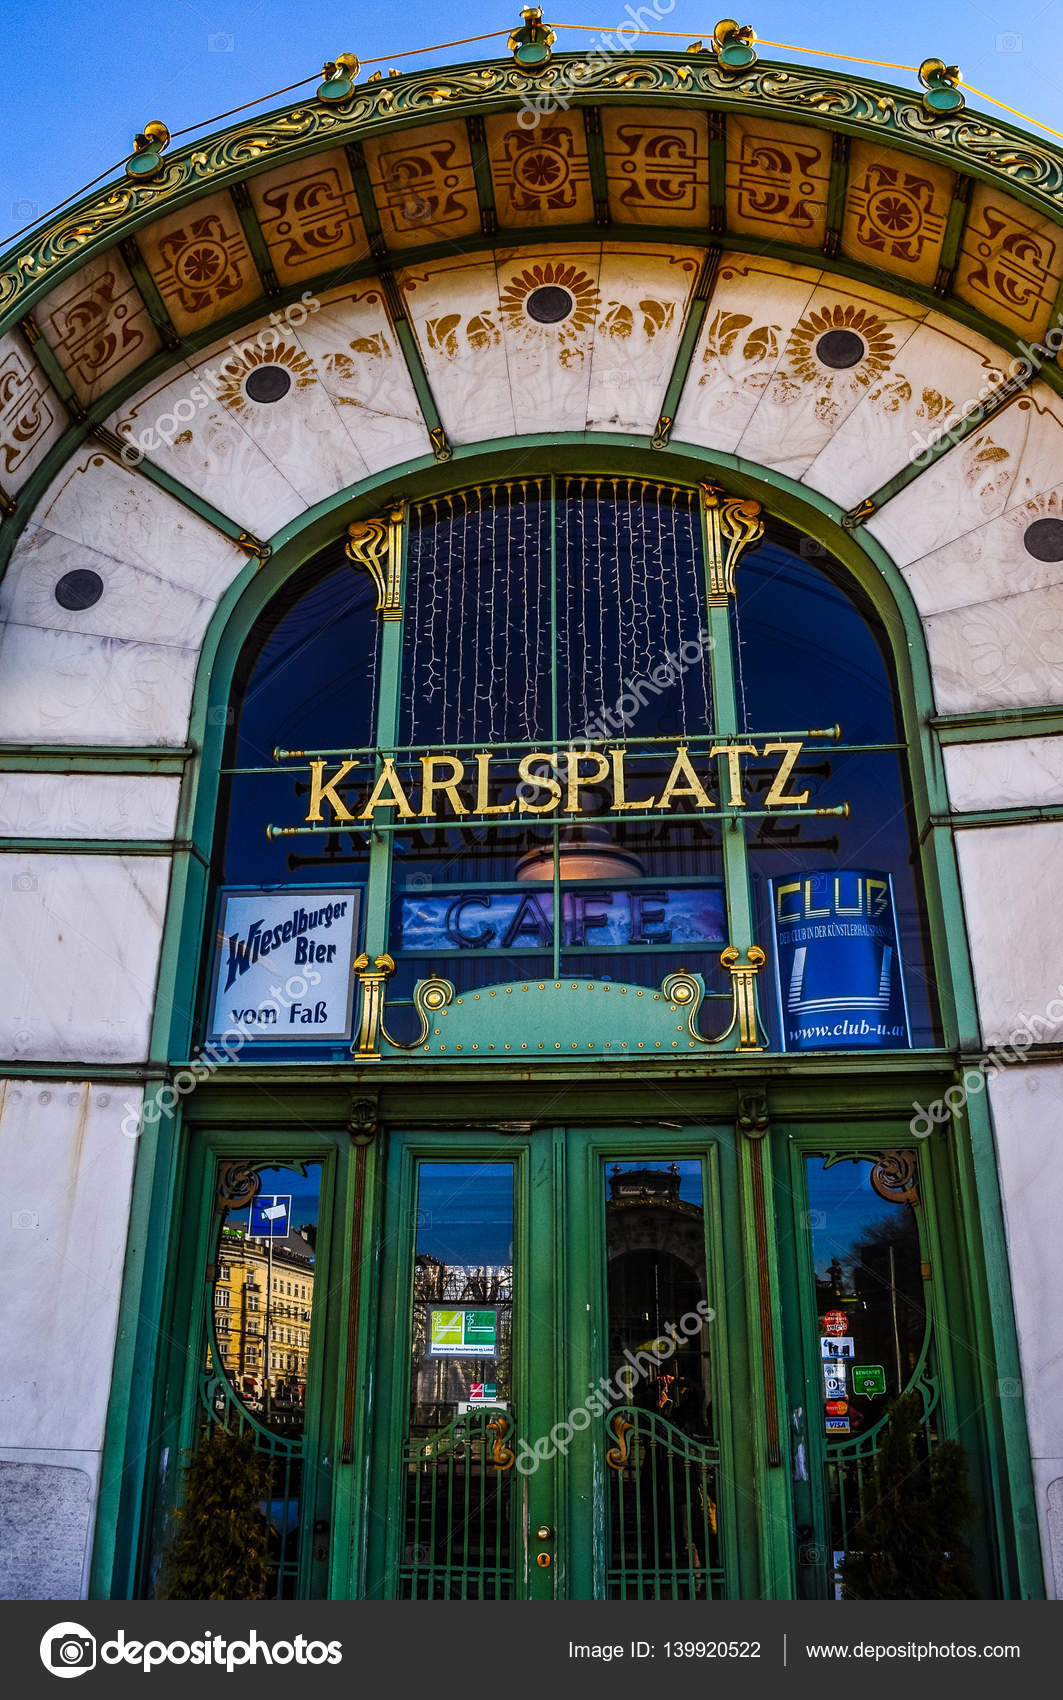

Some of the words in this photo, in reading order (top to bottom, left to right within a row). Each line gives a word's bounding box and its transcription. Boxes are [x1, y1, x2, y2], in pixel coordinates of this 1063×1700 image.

[305, 742, 809, 821] KARLSPLATZ
[446, 891, 673, 948] CAFE
[777, 878, 888, 924] CLUB
[224, 901, 348, 994] Wieselburger
[294, 936, 337, 965] Bier
[232, 1007, 278, 1025] vom
[289, 1001, 328, 1024] Faß
[789, 1019, 905, 1042] www.club-u.at
